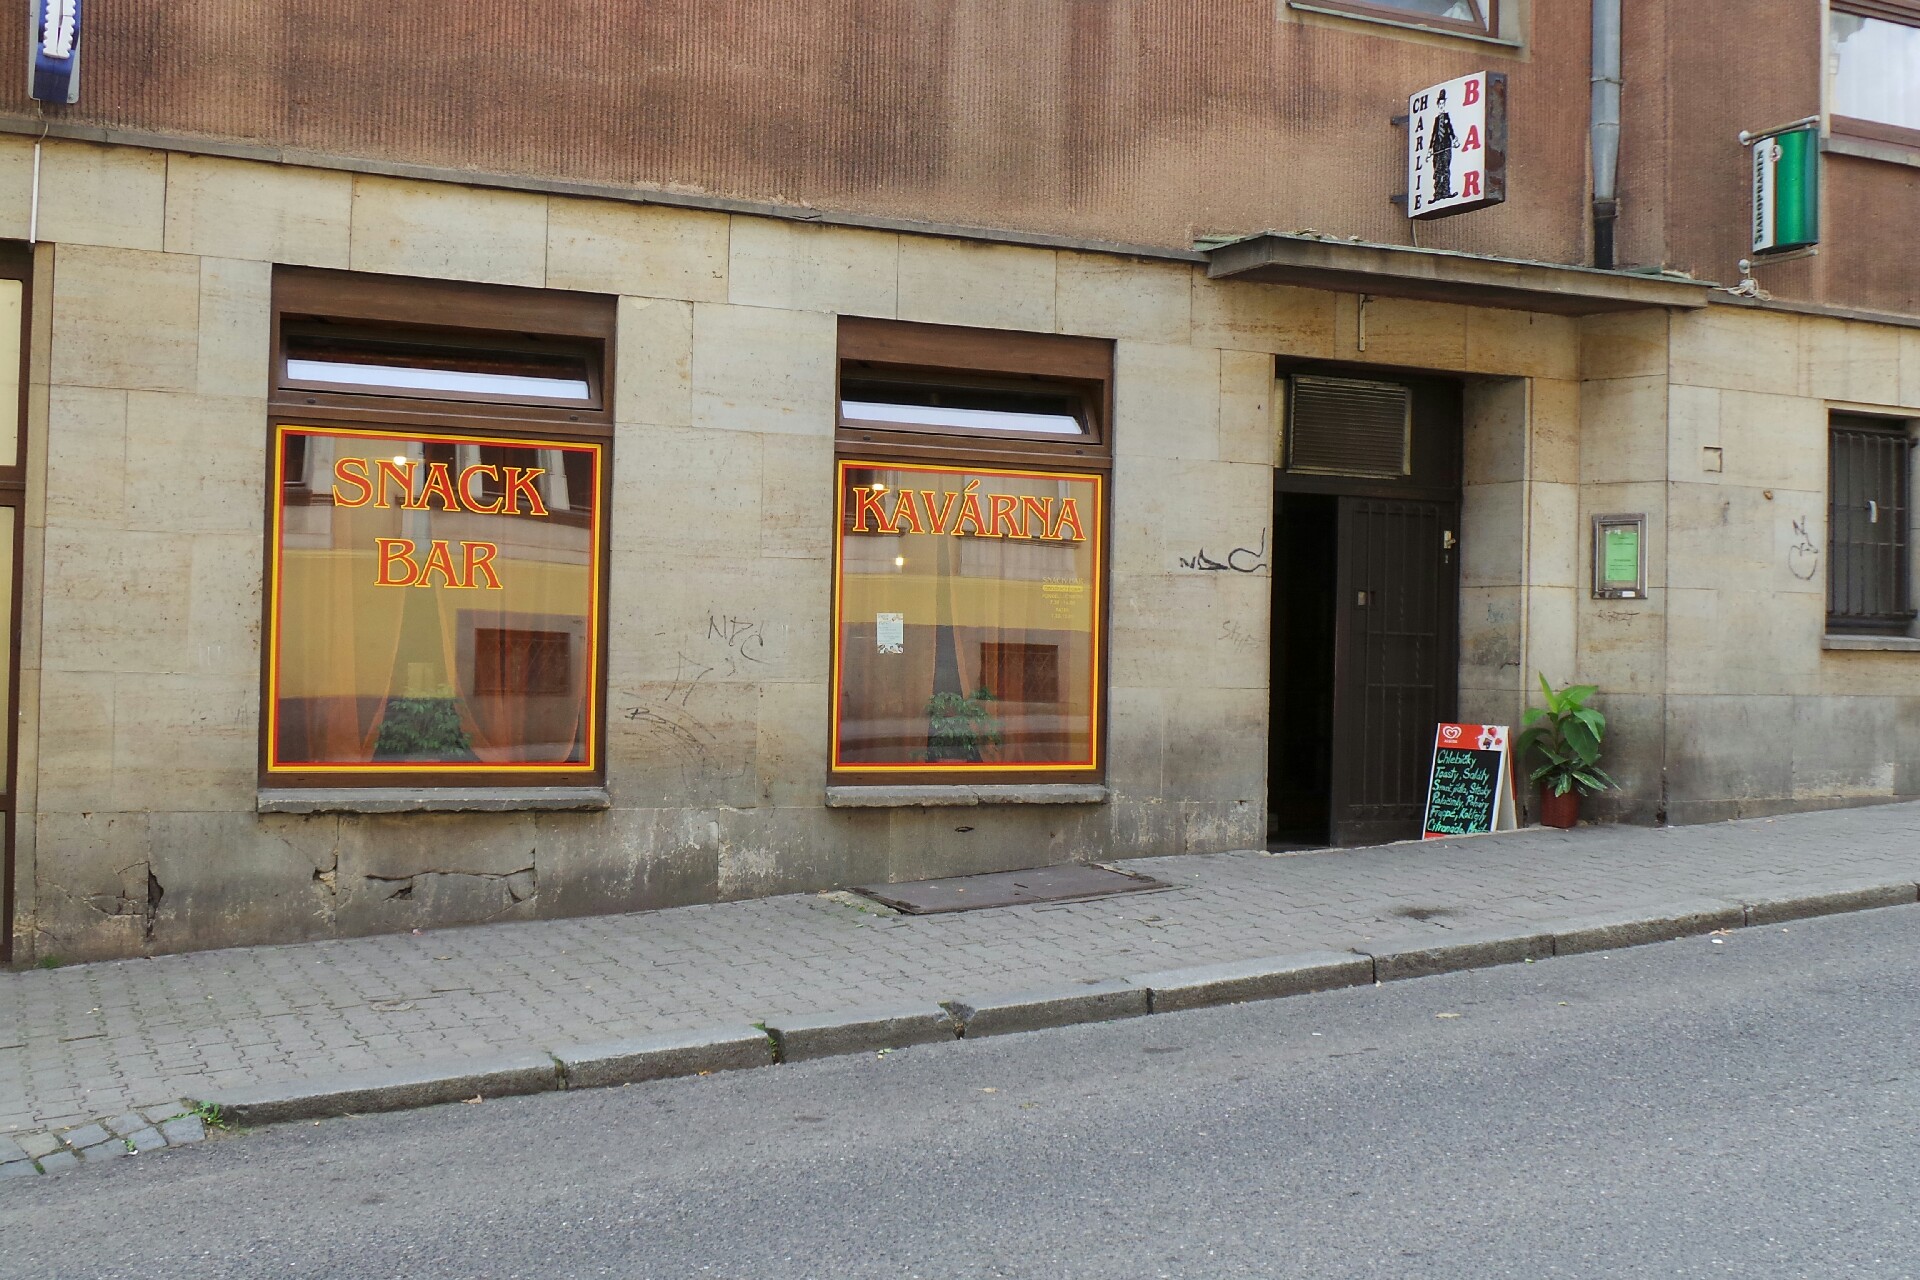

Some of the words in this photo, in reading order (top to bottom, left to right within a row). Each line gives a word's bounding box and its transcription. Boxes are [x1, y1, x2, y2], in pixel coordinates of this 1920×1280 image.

[1462, 79, 1481, 197] BAR
[331, 456, 549, 516] SNACK
[852, 479, 1087, 541] KAVÁRNA
[373, 537, 503, 590] BAR
